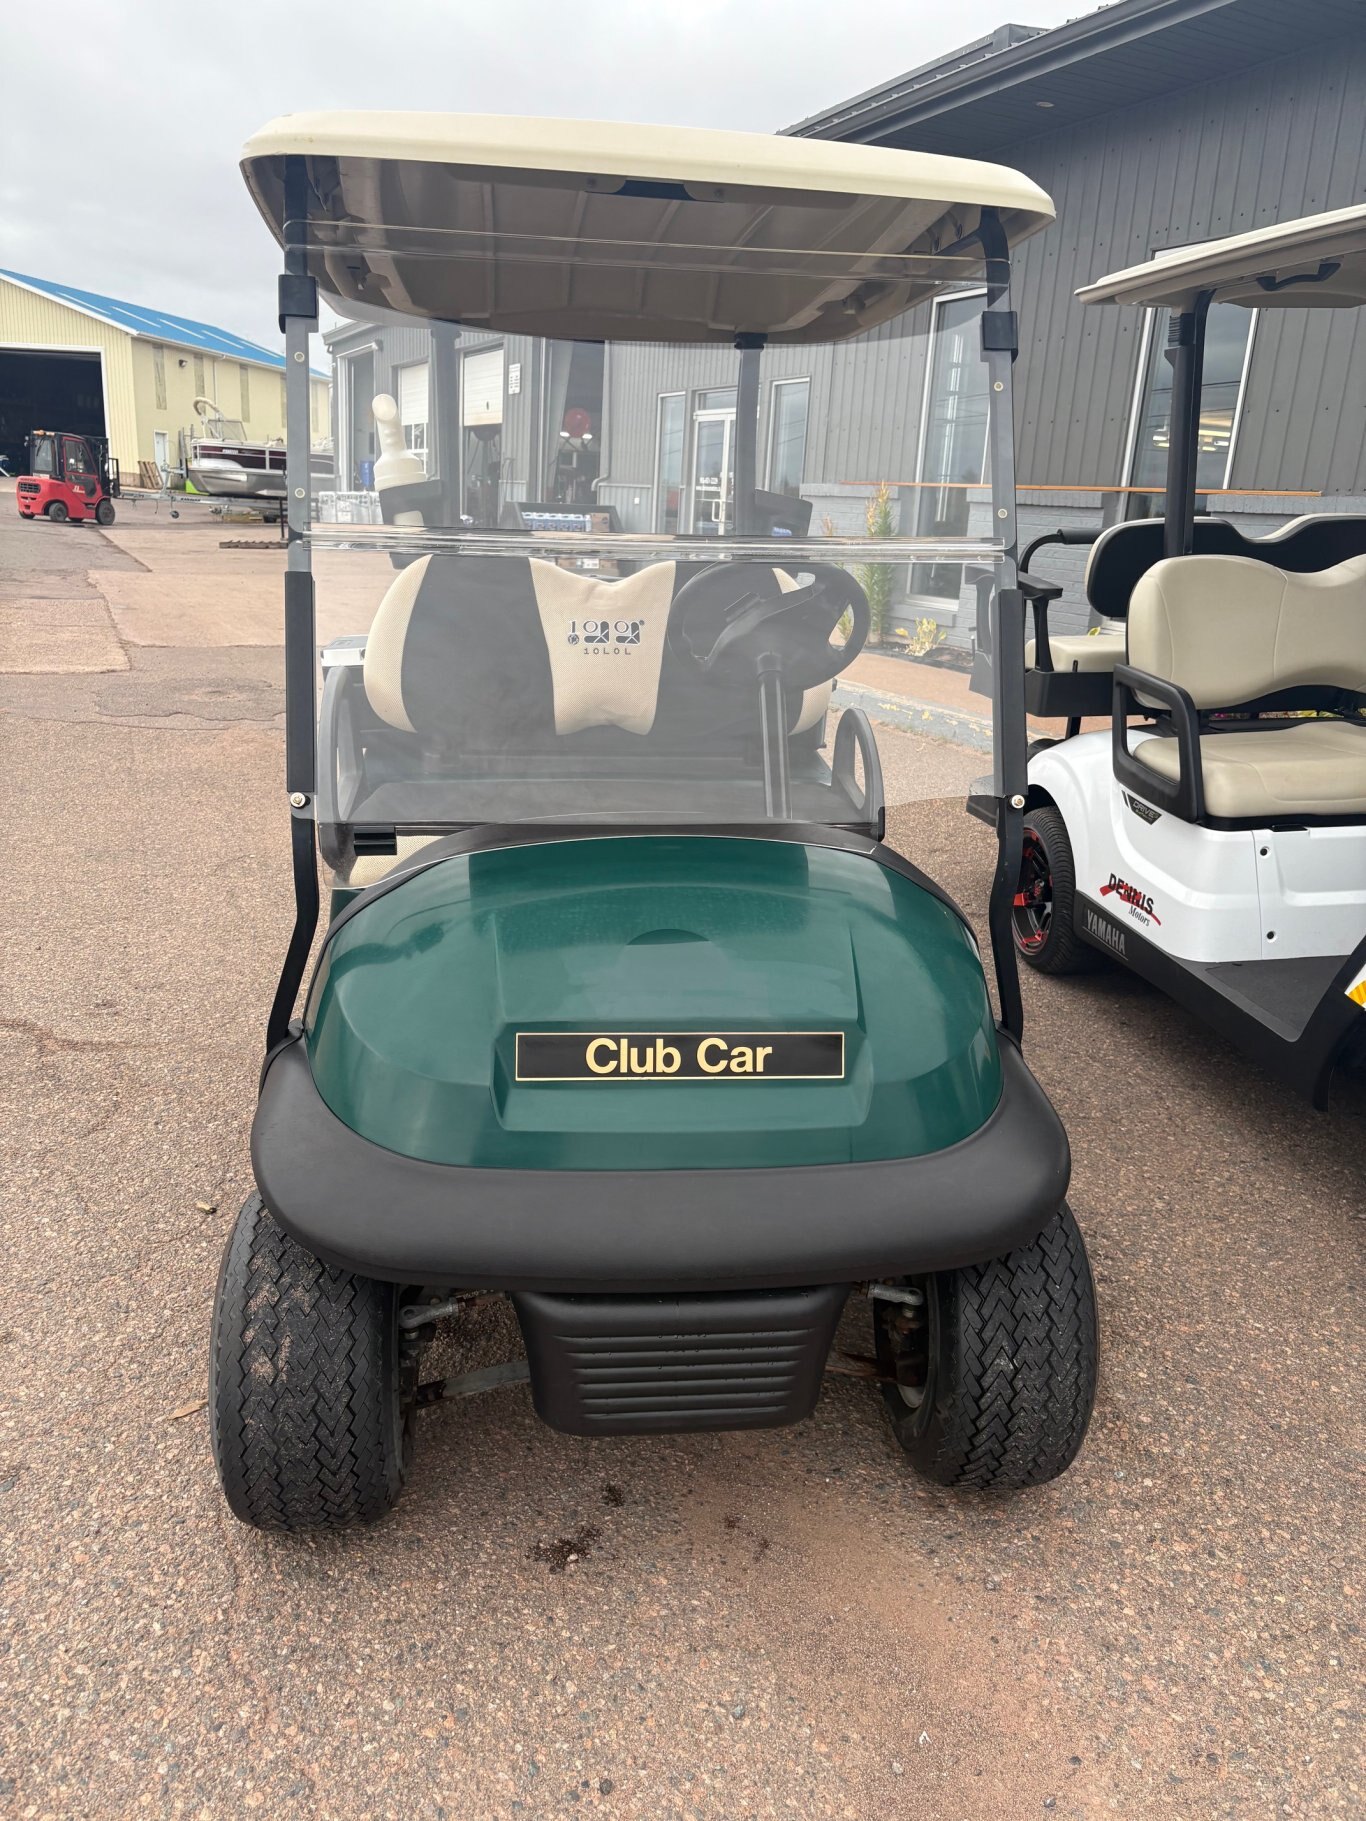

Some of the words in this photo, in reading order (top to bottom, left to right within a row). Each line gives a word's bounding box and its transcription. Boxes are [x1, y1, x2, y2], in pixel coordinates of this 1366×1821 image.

[1108, 872, 1154, 915] DENNIS
[1087, 908, 1126, 955] YAMAHA
[1128, 905, 1151, 927] Motors
[585, 1037, 682, 1074] Club
[696, 1037, 773, 1074] Car
